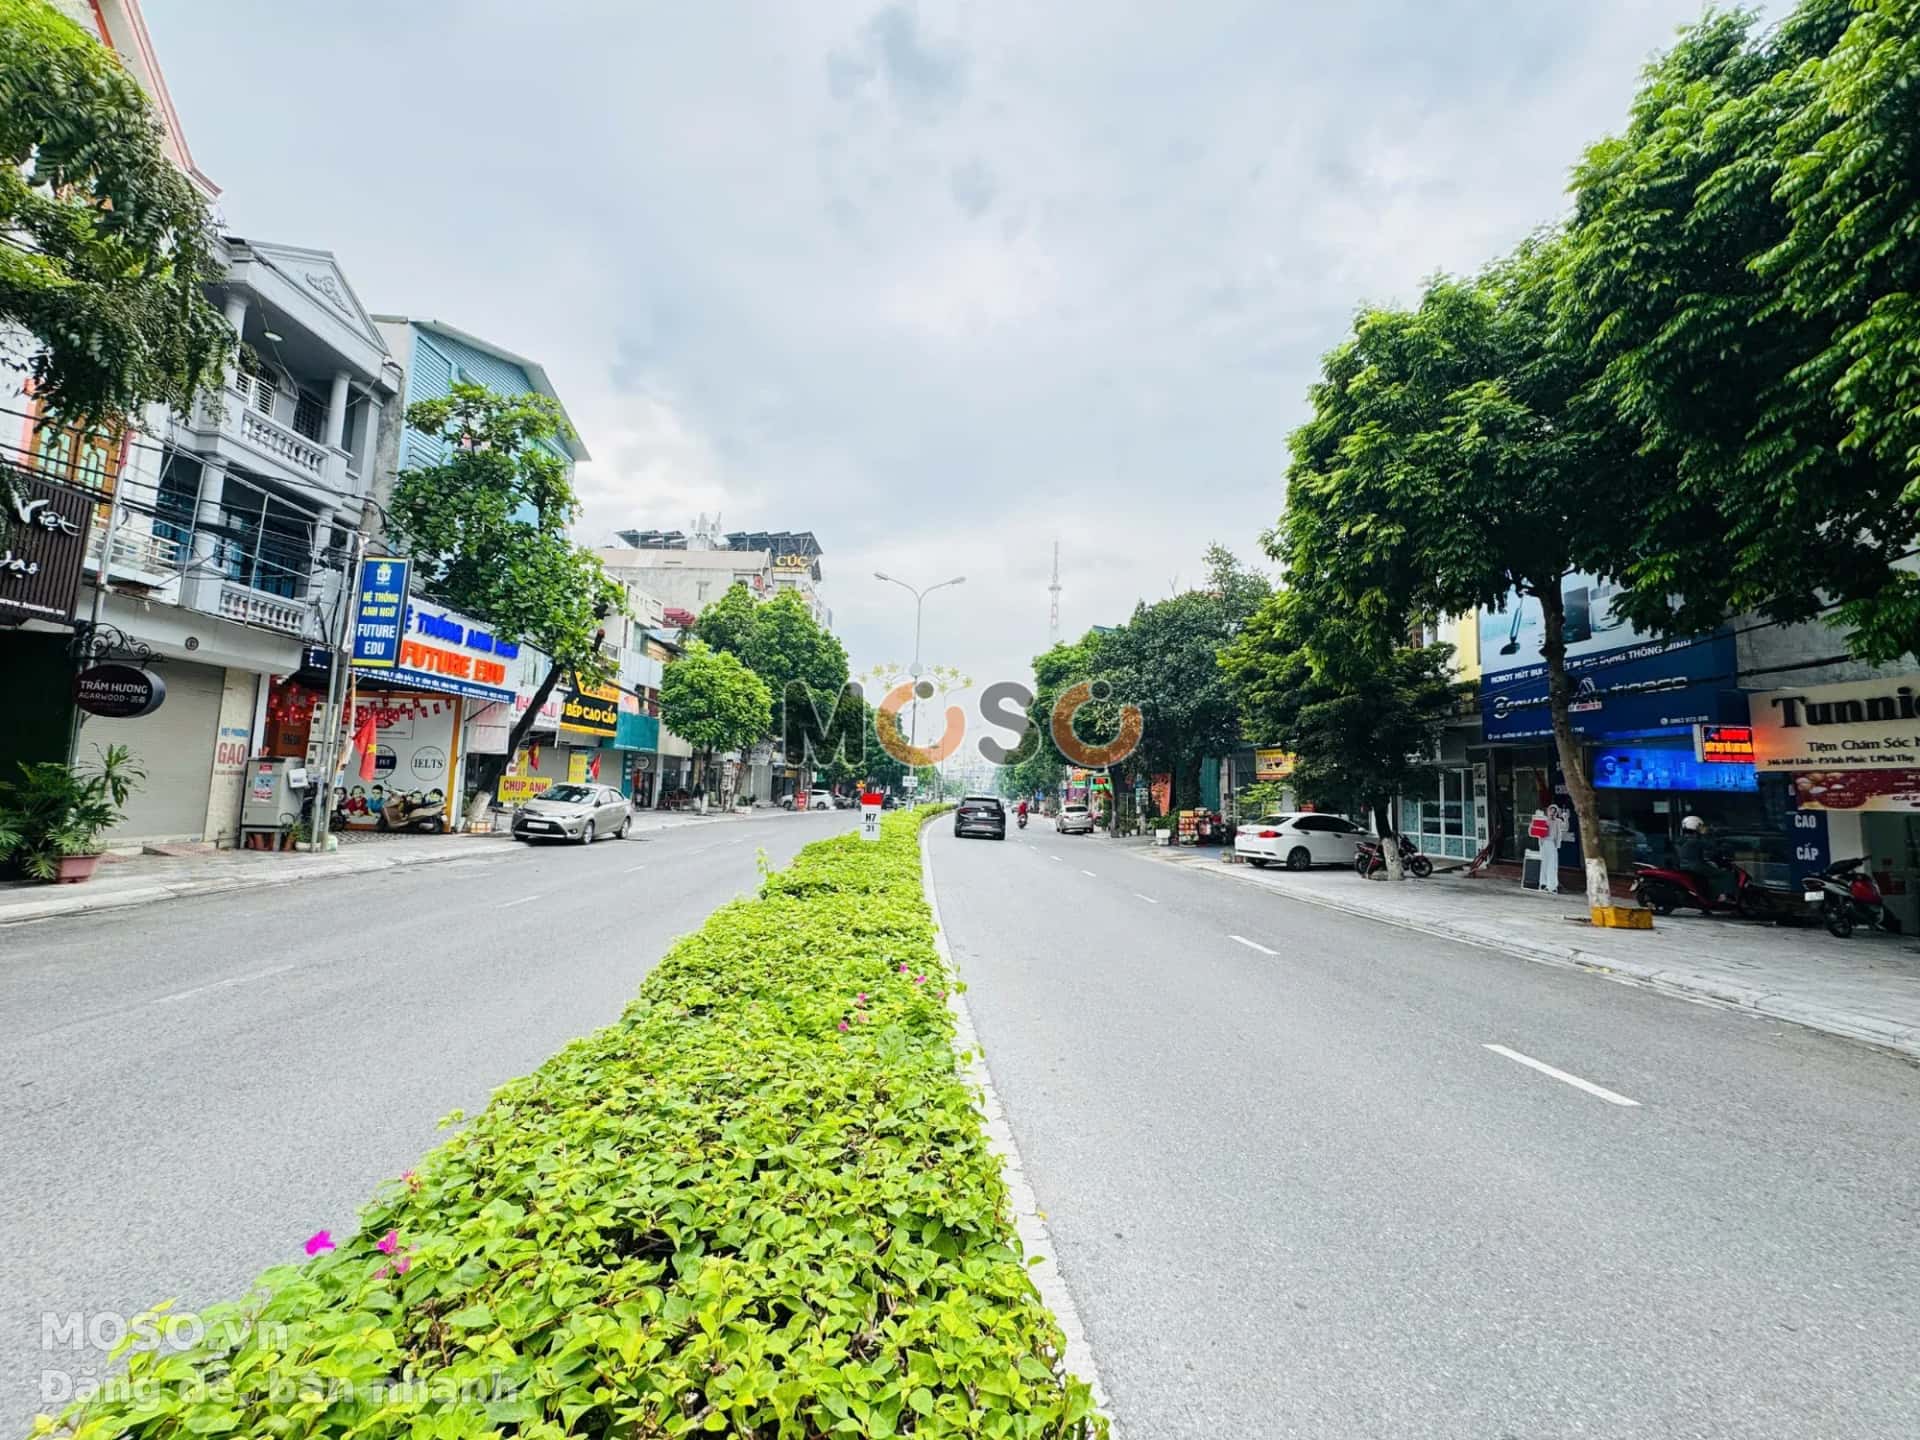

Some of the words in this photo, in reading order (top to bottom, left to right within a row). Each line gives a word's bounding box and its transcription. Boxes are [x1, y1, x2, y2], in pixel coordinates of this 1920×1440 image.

[357, 624, 396, 638] FUTURE
[364, 641, 385, 655] EDU
[1628, 645, 1663, 659] THÔNG
[400, 640, 472, 678] FUTURE
[473, 659, 506, 685] EDU
[566, 698, 582, 716] BẾP
[583, 709, 601, 722] CAO
[1806, 741, 1837, 753] Tiệm
[414, 758, 443, 769] IELTS
[865, 813, 876, 822] H7
[1795, 815, 1816, 828] CAO
[1796, 843, 1819, 860] CẤP
